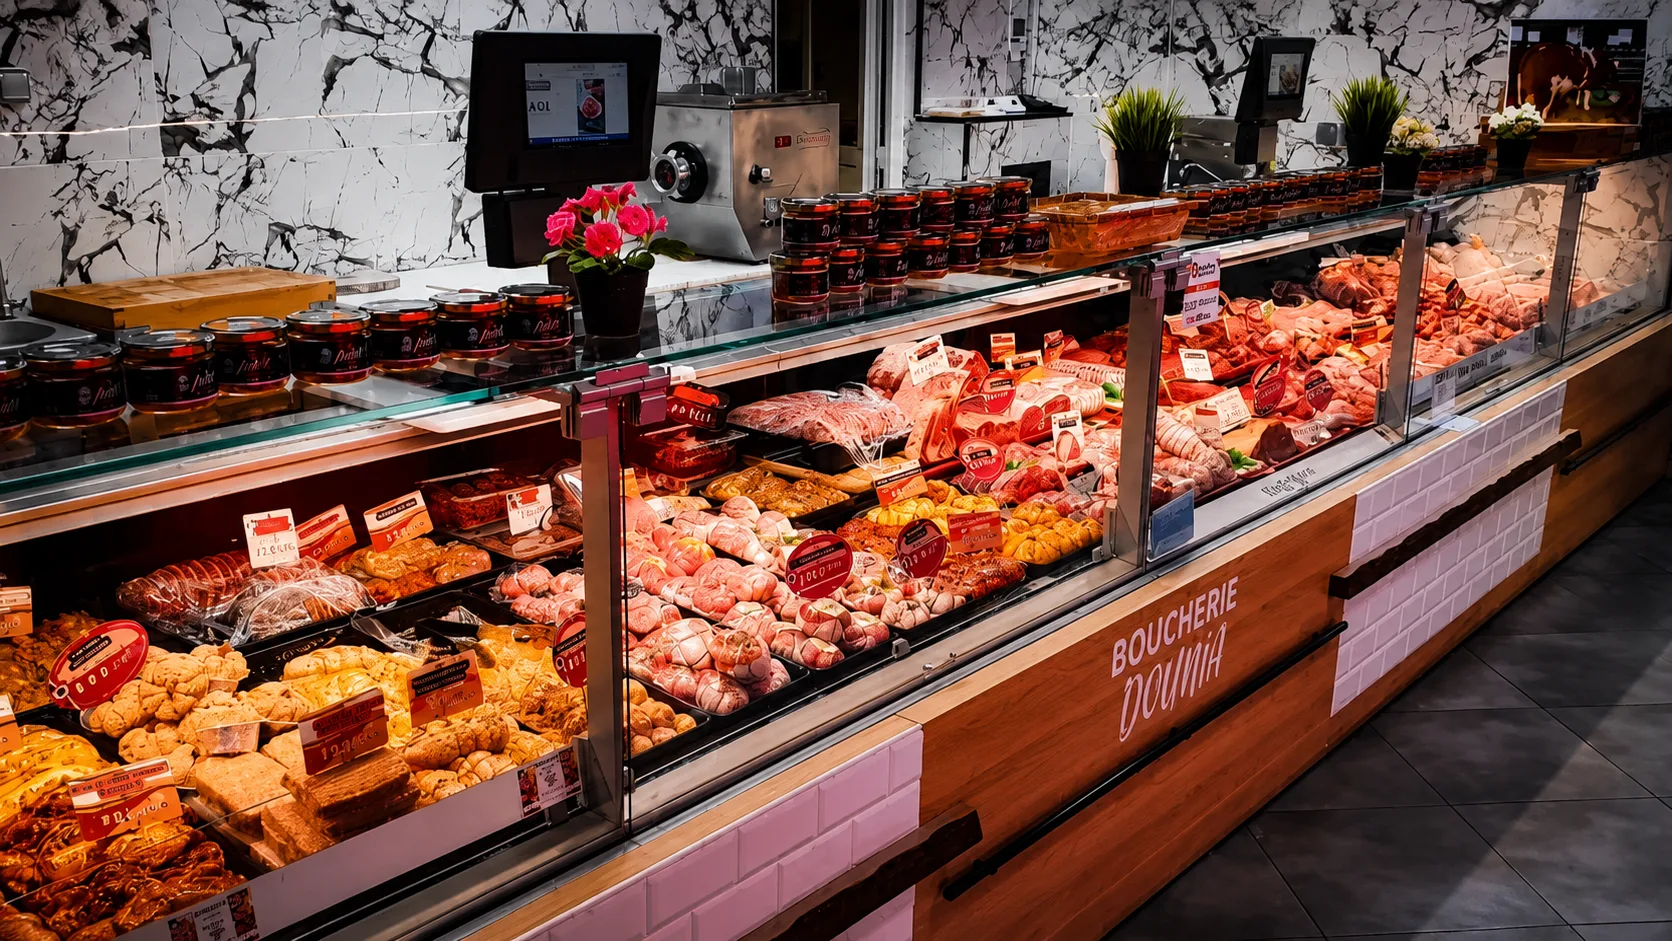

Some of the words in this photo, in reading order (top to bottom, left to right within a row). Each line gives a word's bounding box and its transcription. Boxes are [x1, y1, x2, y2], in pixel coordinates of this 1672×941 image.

[528, 101, 551, 113] AOL
[1111, 576, 1239, 679] BOUCHERIE
[1119, 621, 1228, 743] DOUNIA
